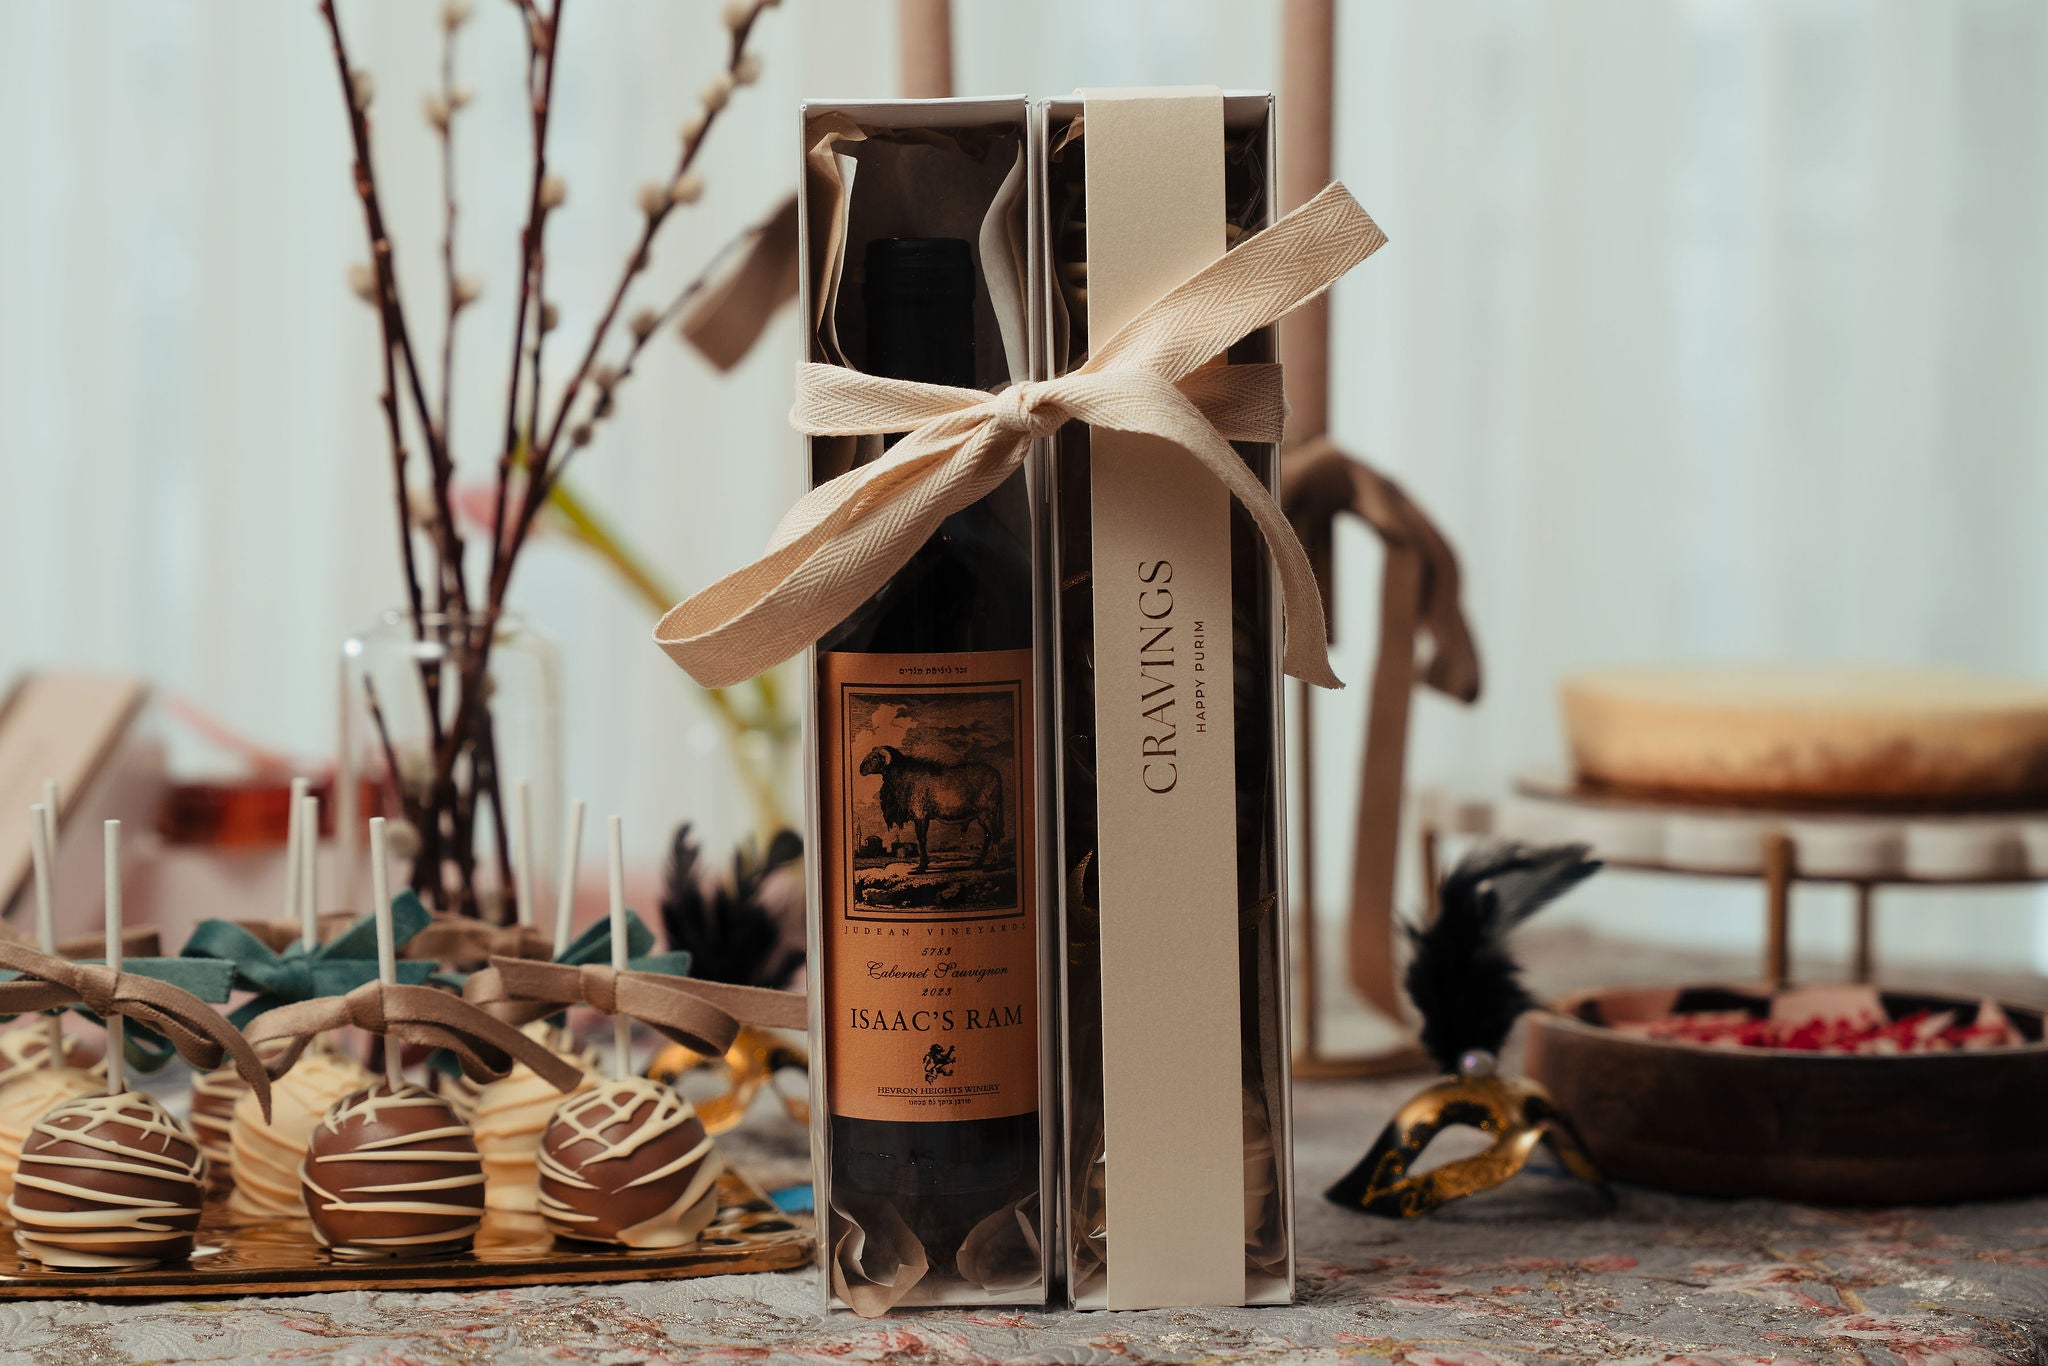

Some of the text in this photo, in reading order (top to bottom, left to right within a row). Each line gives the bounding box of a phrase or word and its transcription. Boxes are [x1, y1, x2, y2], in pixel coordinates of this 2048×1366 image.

[1138, 559, 1178, 794] CRAVINGS
[1193, 620, 1207, 732] HAPPY PURIM
[844, 922, 1026, 936] JUDEAN VINEYARDS
[921, 947, 952, 956] 5783
[866, 960, 1008, 983] Cabernet Sauvignon
[921, 987, 952, 997] 2023
[966, 1004, 1024, 1030] RAM
[877, 1084, 1000, 1095] HEVRON HEIGHTS WINERY
